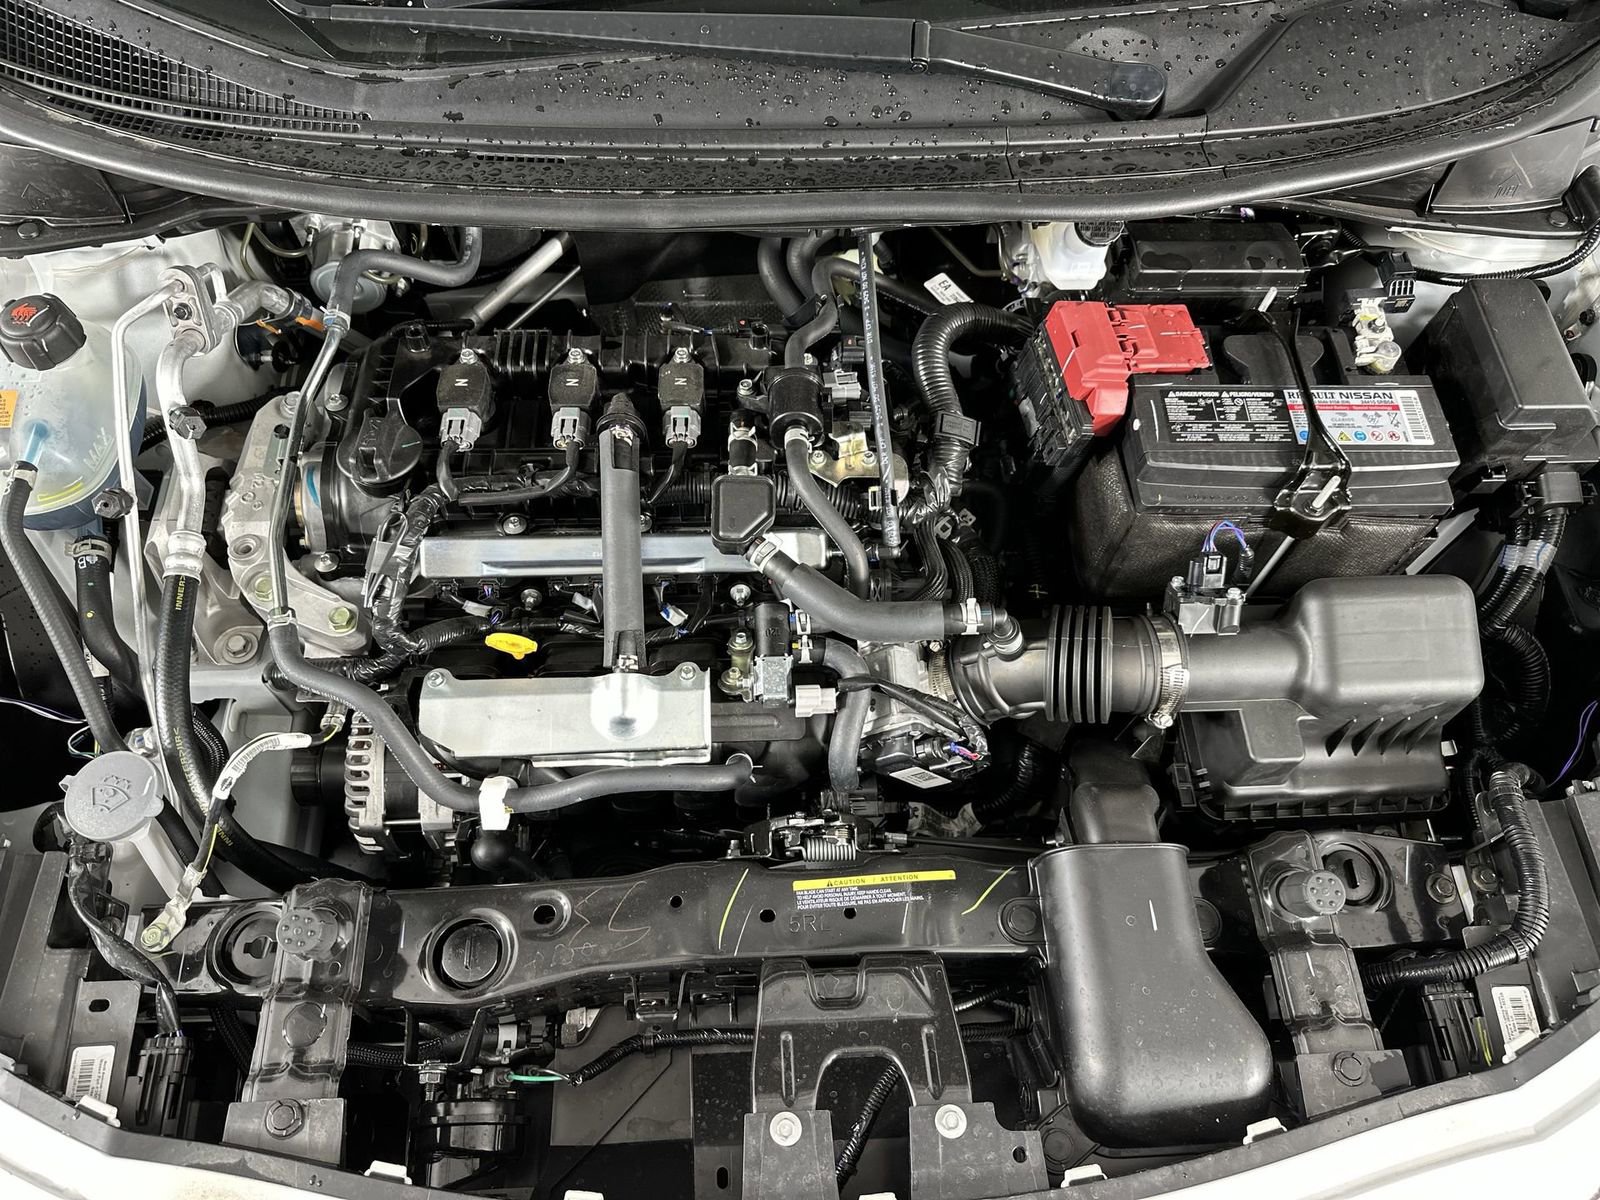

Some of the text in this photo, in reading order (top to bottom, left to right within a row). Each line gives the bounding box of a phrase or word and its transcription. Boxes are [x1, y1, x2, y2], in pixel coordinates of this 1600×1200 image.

[939, 280, 951, 291] EA
[1340, 392, 1393, 400] NISSAN
[834, 878, 866, 886] CAUTION
[880, 874, 919, 882] ATTENTION
